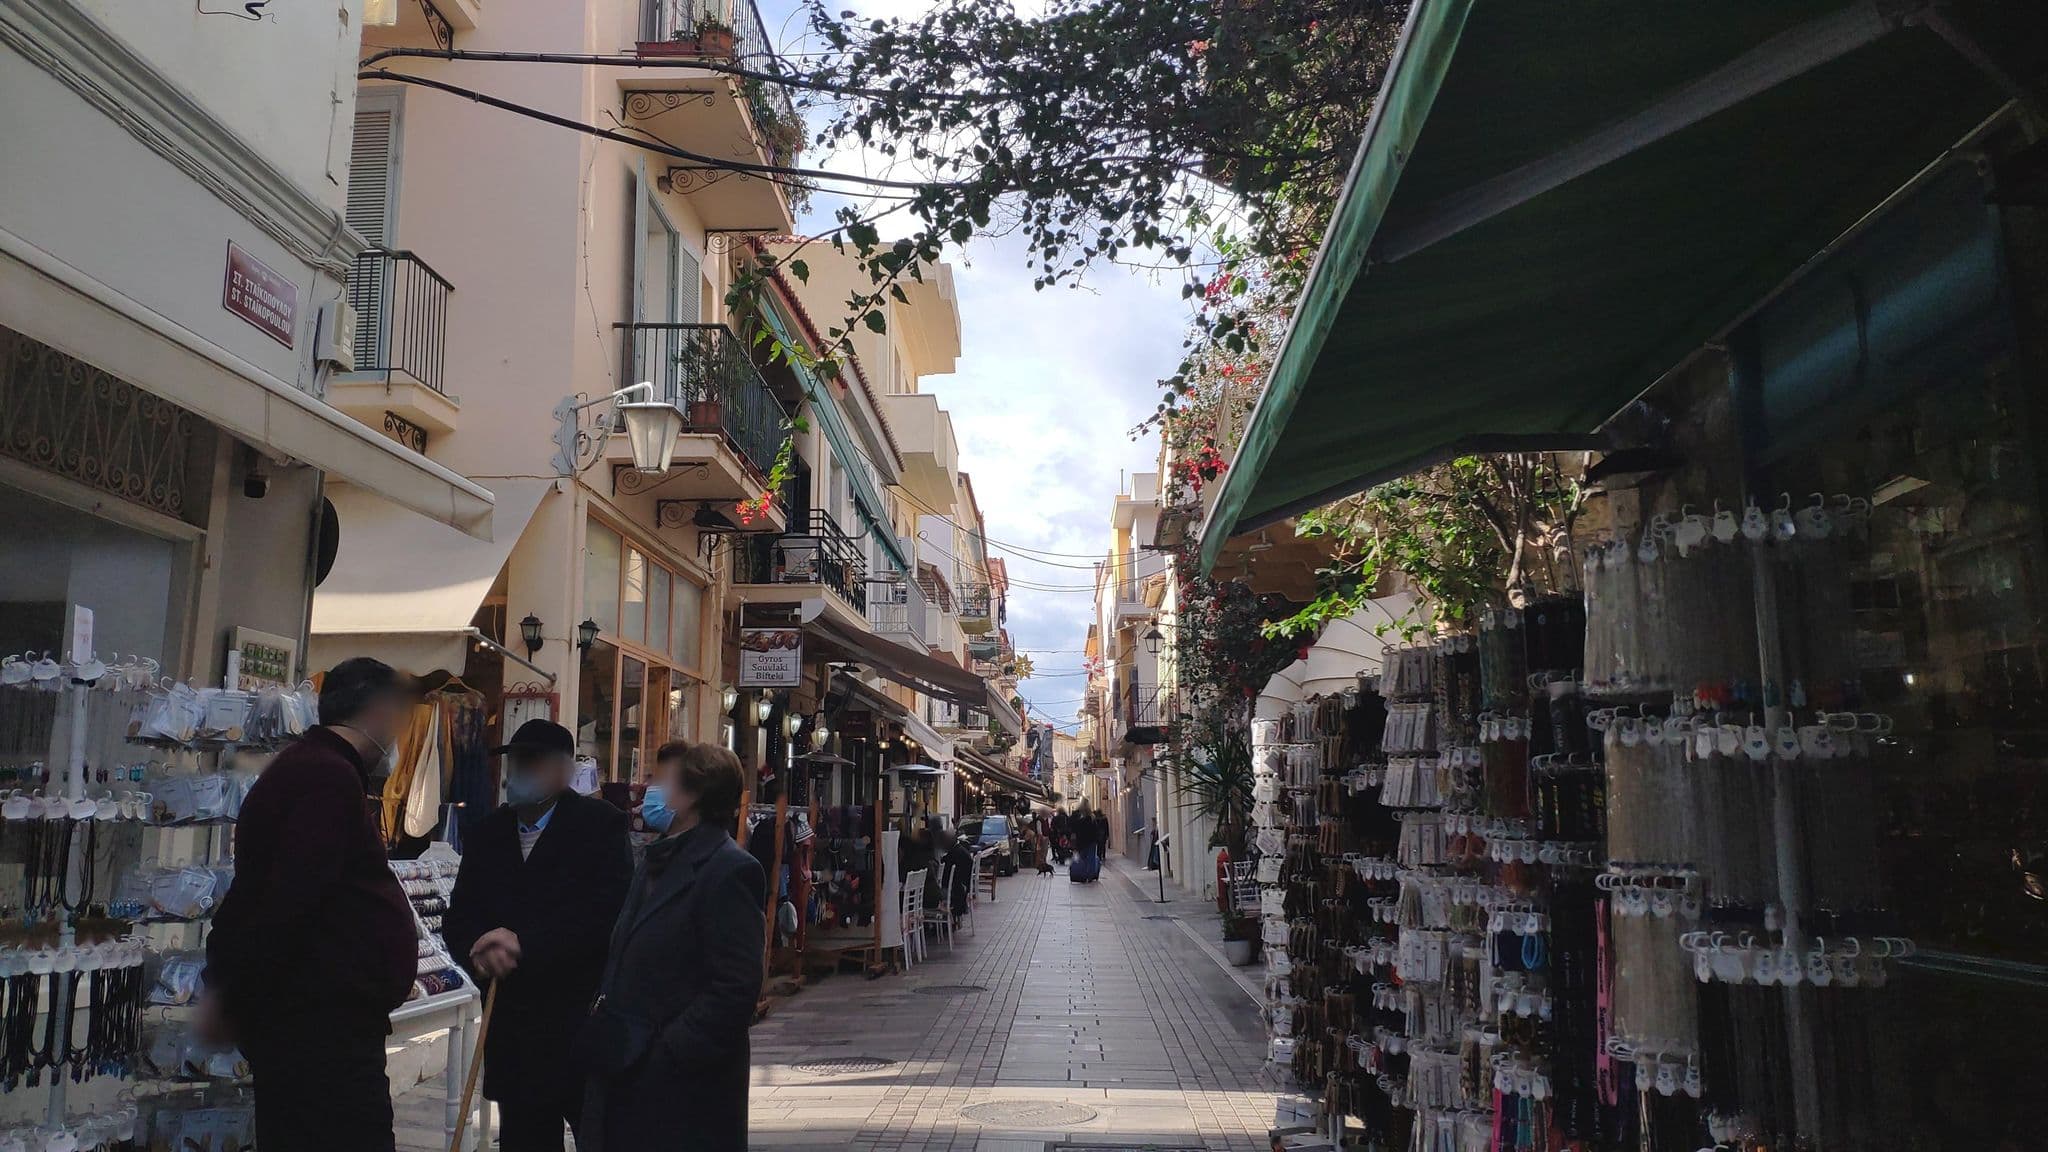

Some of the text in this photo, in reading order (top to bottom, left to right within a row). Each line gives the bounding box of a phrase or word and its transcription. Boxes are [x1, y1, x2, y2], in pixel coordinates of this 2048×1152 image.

[231, 287, 242, 304] ST.
[758, 655, 783, 664] Gyros
[751, 663, 788, 671] Souvlaki
[756, 671, 784, 680] Bifteki
